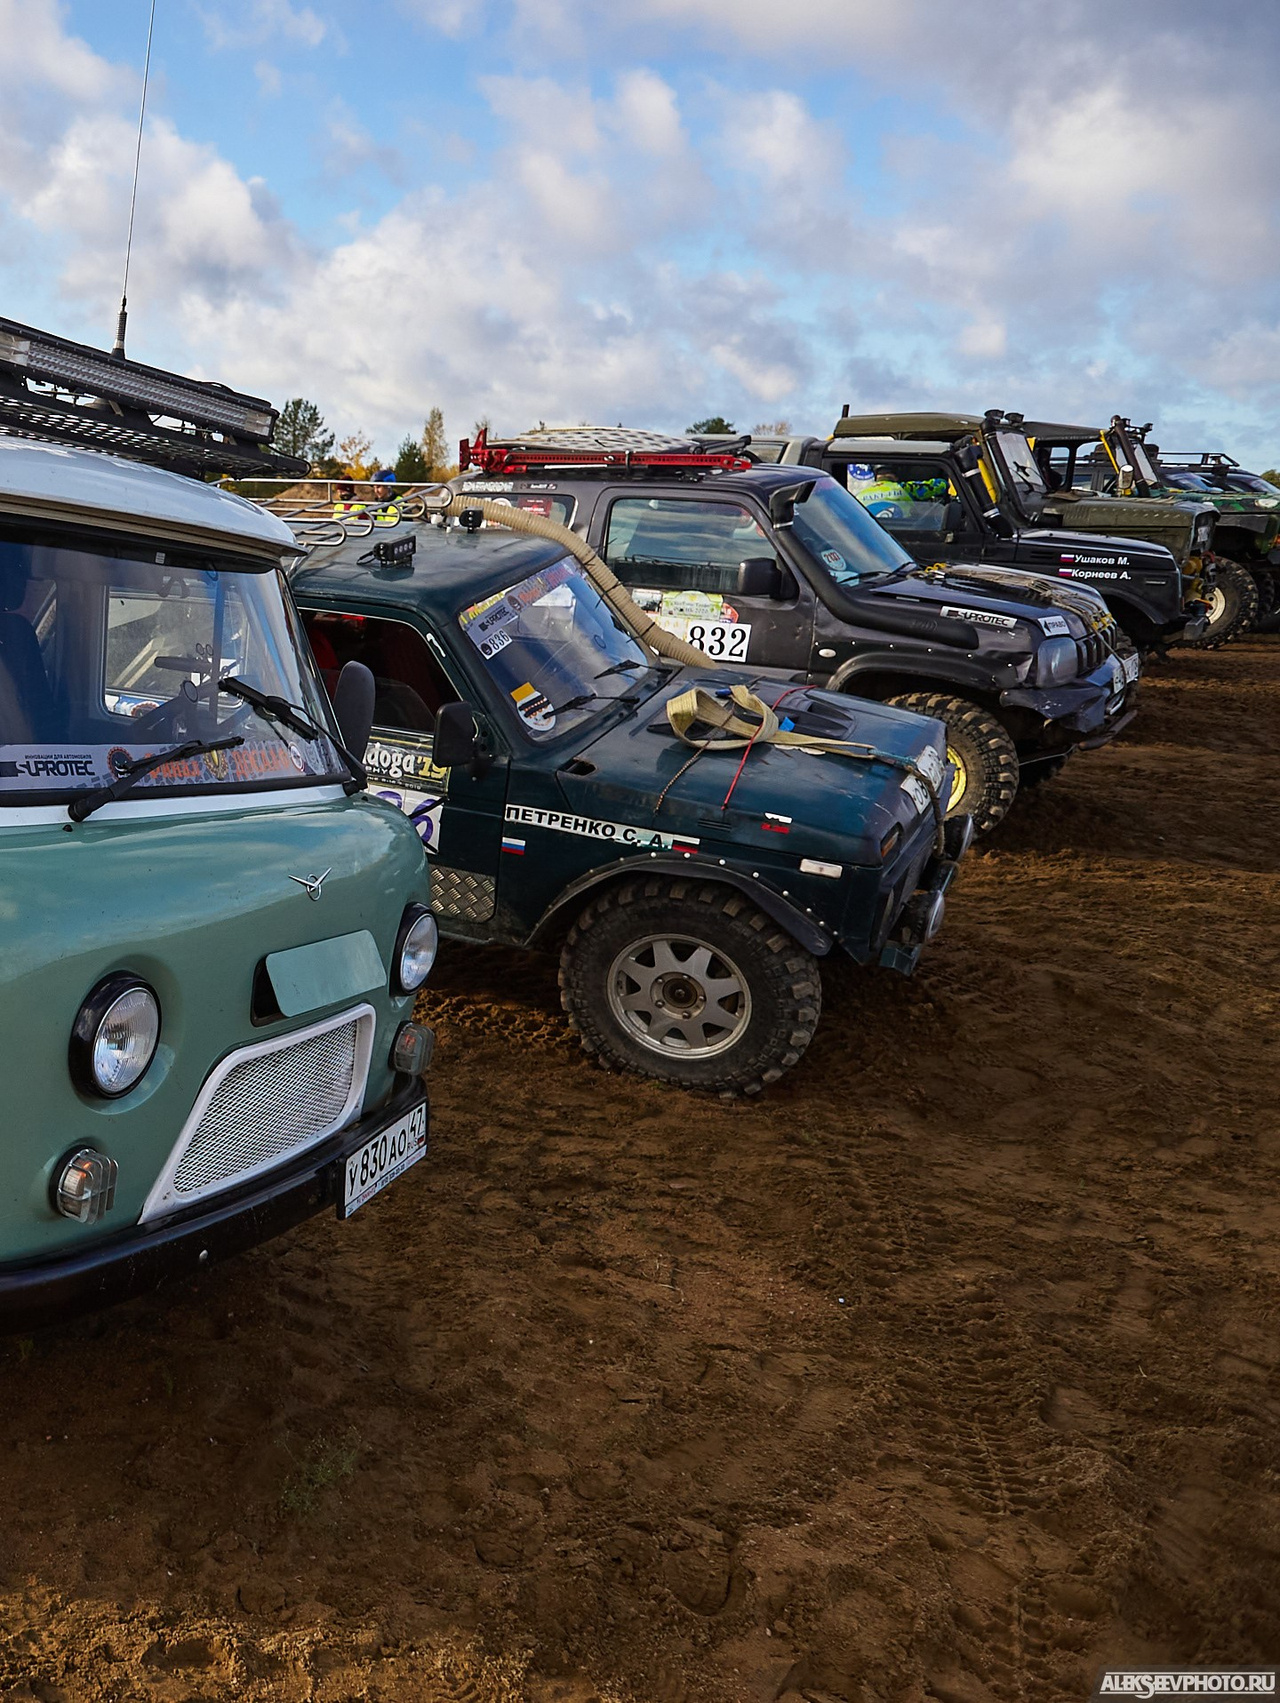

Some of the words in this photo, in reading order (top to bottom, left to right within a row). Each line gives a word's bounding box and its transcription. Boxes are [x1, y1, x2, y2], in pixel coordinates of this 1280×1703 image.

[1075, 554, 1115, 565] Ушаков
[1117, 556, 1130, 565] М.
[1071, 568, 1118, 579] Корнеев
[1119, 571, 1132, 580] А.
[958, 612, 1010, 627] SUPROTEC
[488, 630, 510, 650] 836
[687, 625, 746, 658] 832
[16, 760, 96, 777] SUPROTEC
[505, 806, 616, 839] ПЕТРЕНКО
[622, 828, 642, 844] С.
